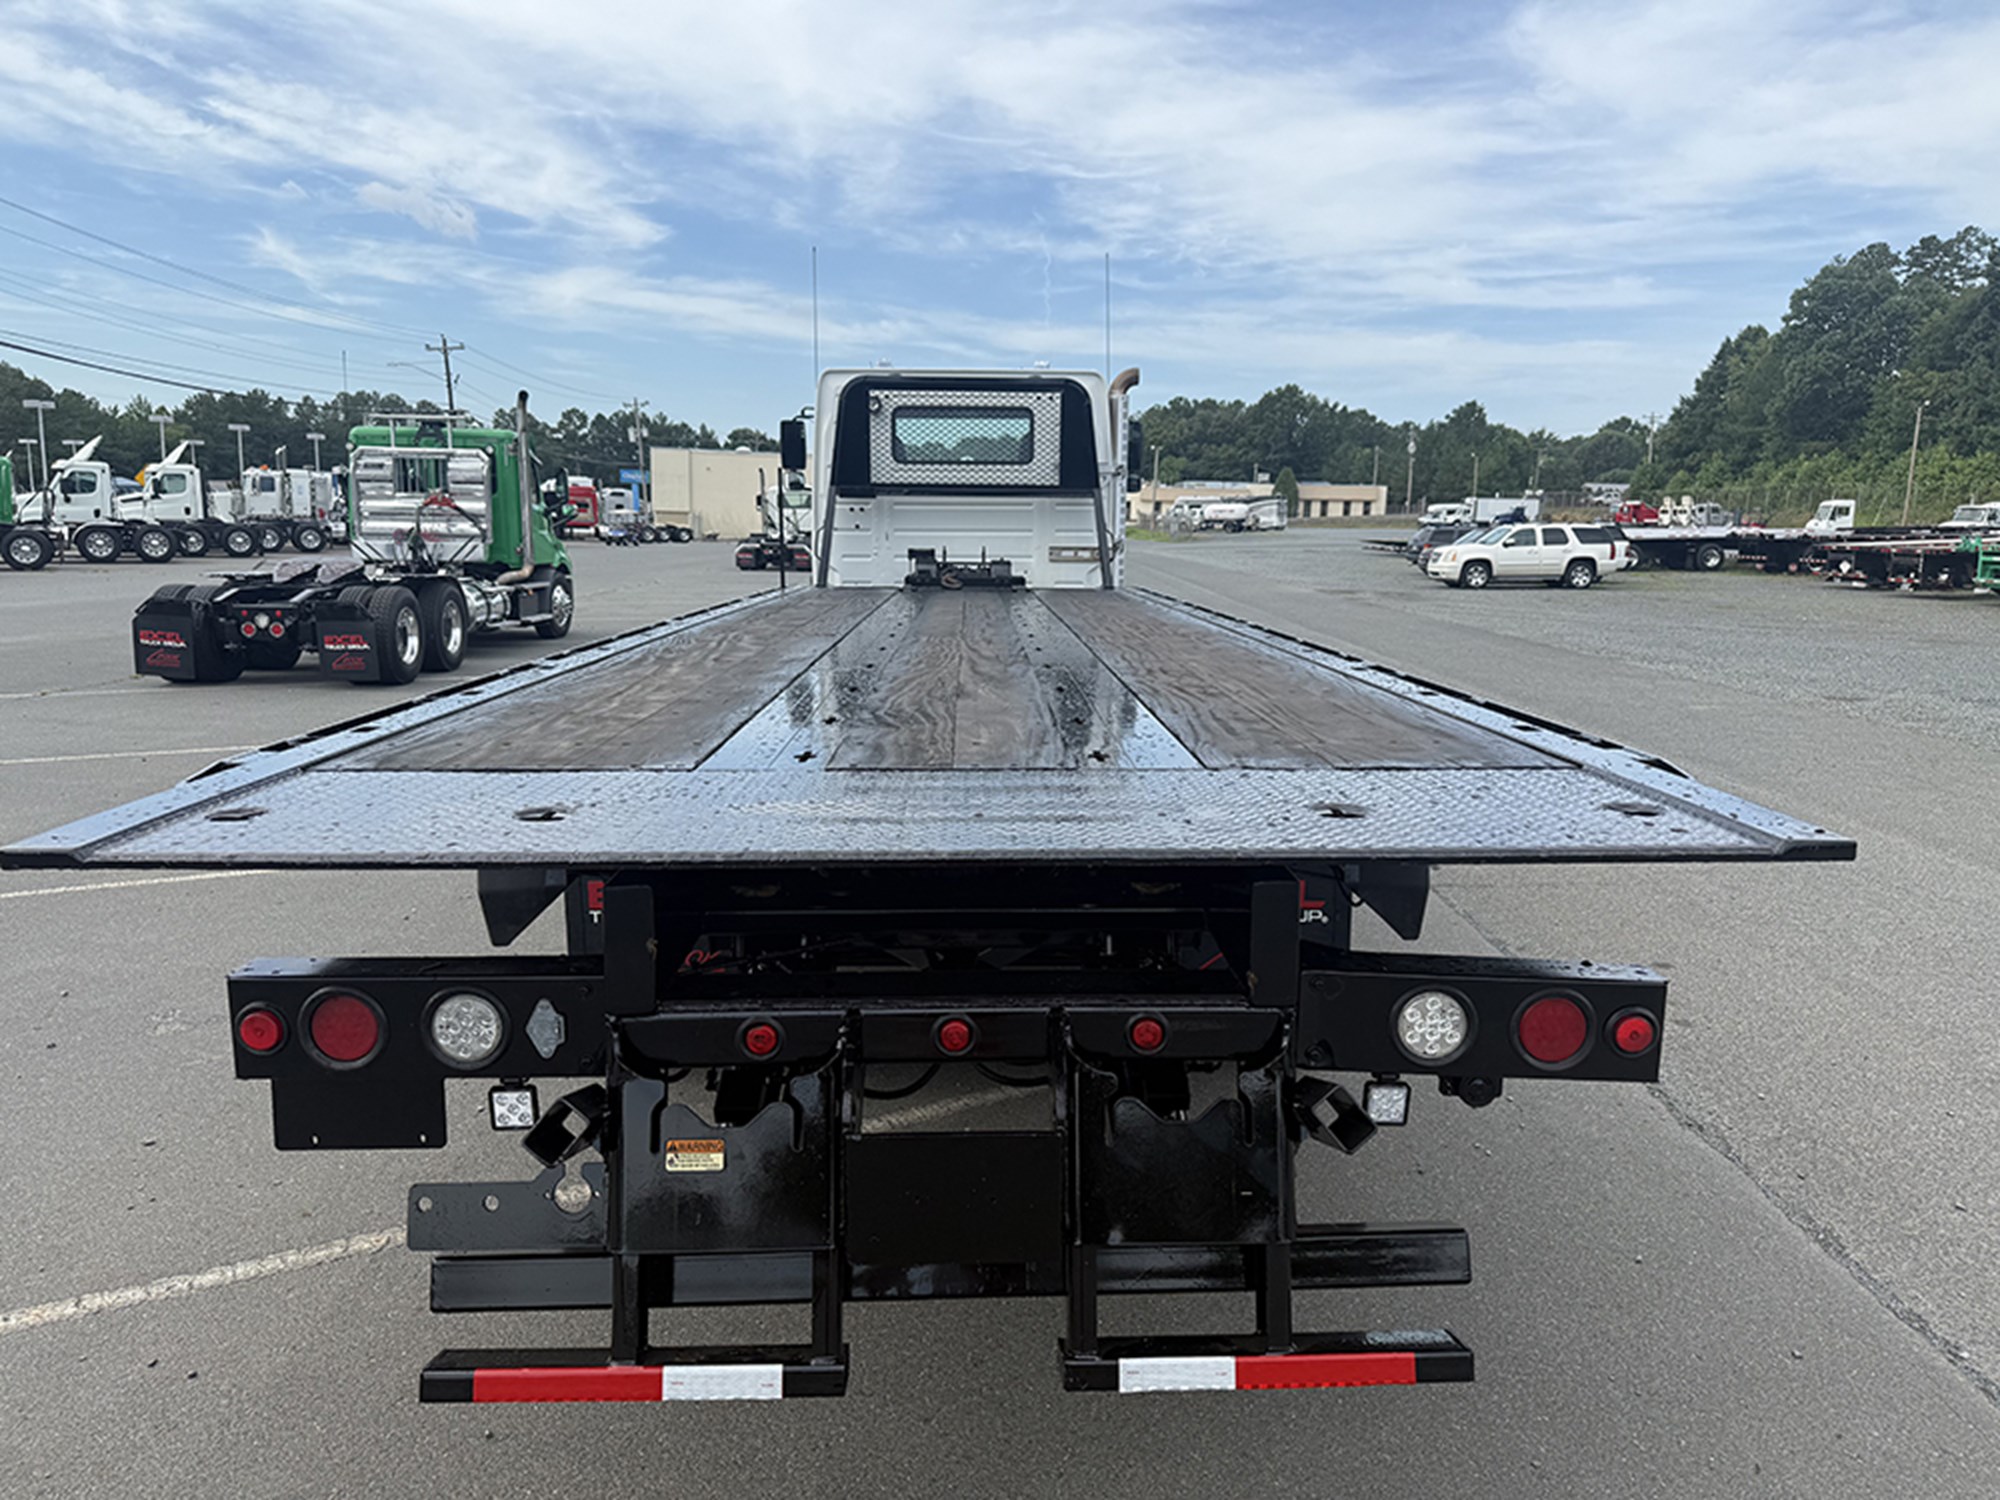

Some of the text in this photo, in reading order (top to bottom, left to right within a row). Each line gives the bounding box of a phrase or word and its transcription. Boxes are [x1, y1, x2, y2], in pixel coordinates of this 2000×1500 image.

[139, 630, 184, 643] EXCEL
[324, 635, 368, 645] EXCEL
[678, 1140, 725, 1152] WARNING
